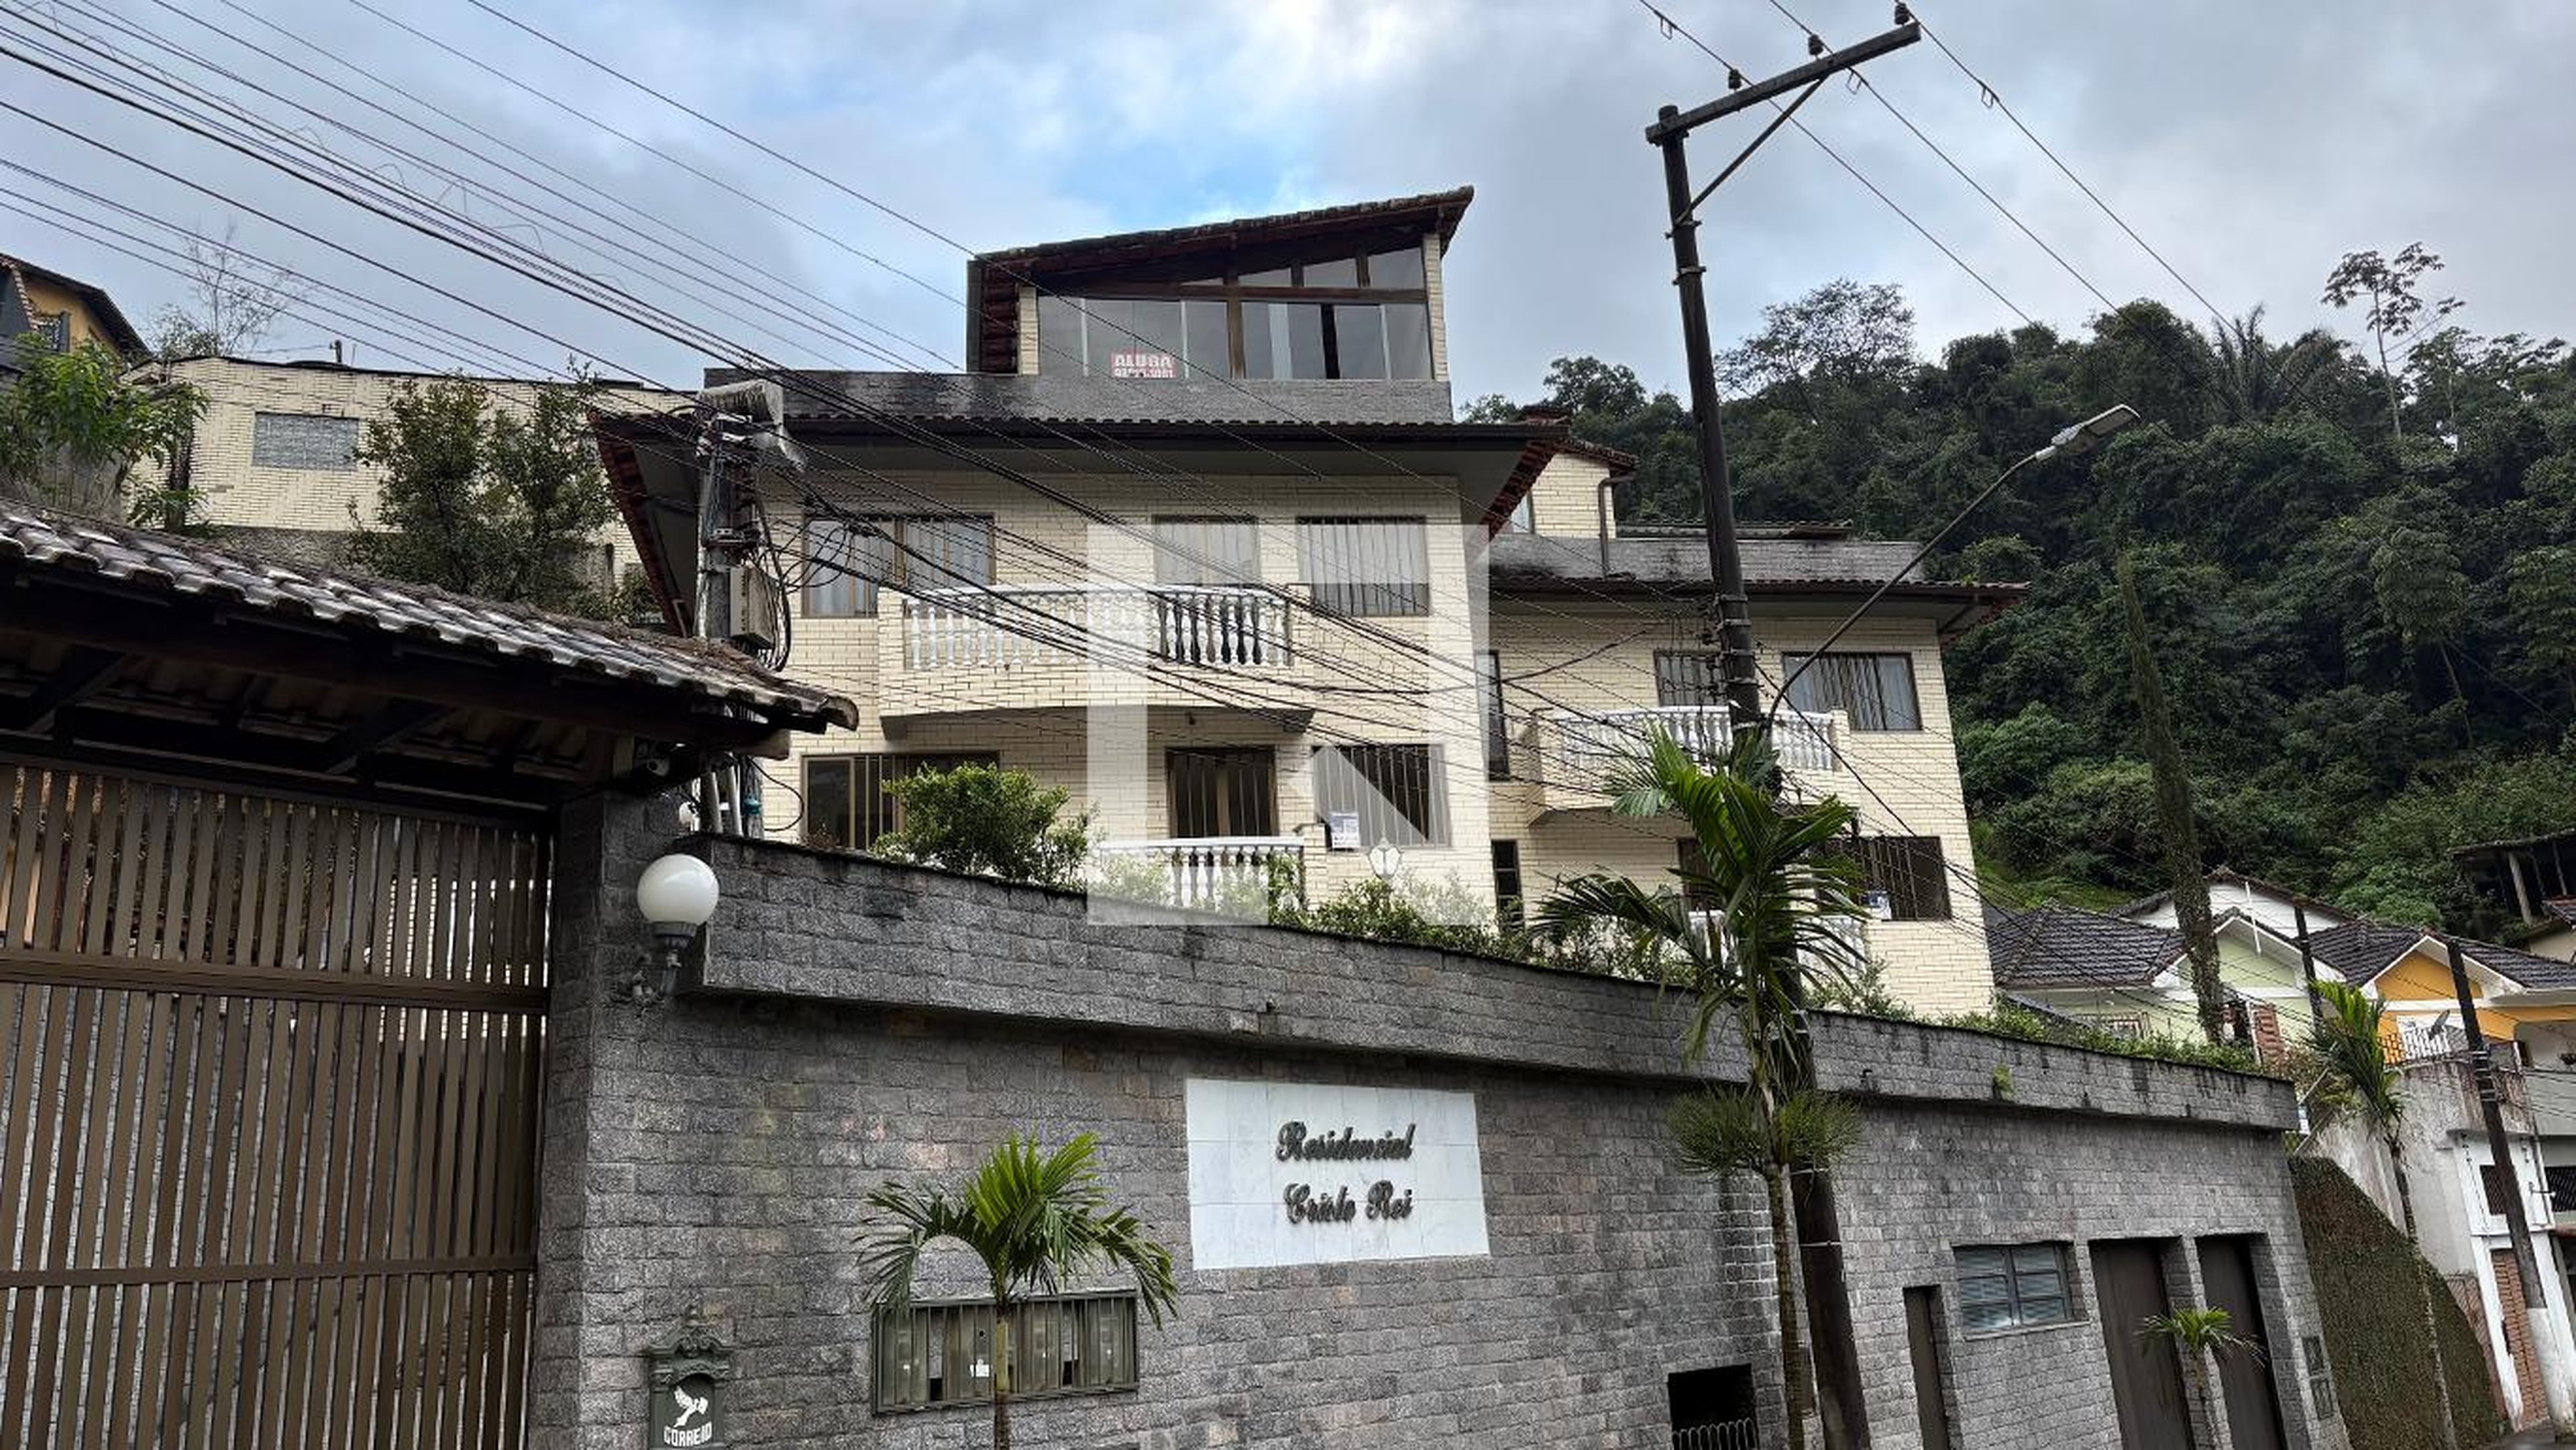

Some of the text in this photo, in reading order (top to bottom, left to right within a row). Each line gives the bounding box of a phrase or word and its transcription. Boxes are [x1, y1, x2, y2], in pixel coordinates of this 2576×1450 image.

[1276, 1121, 1416, 1161] Residencial
[1283, 1180, 1413, 1224] Cristo Rei
[663, 1421, 712, 1447] CORREIO
